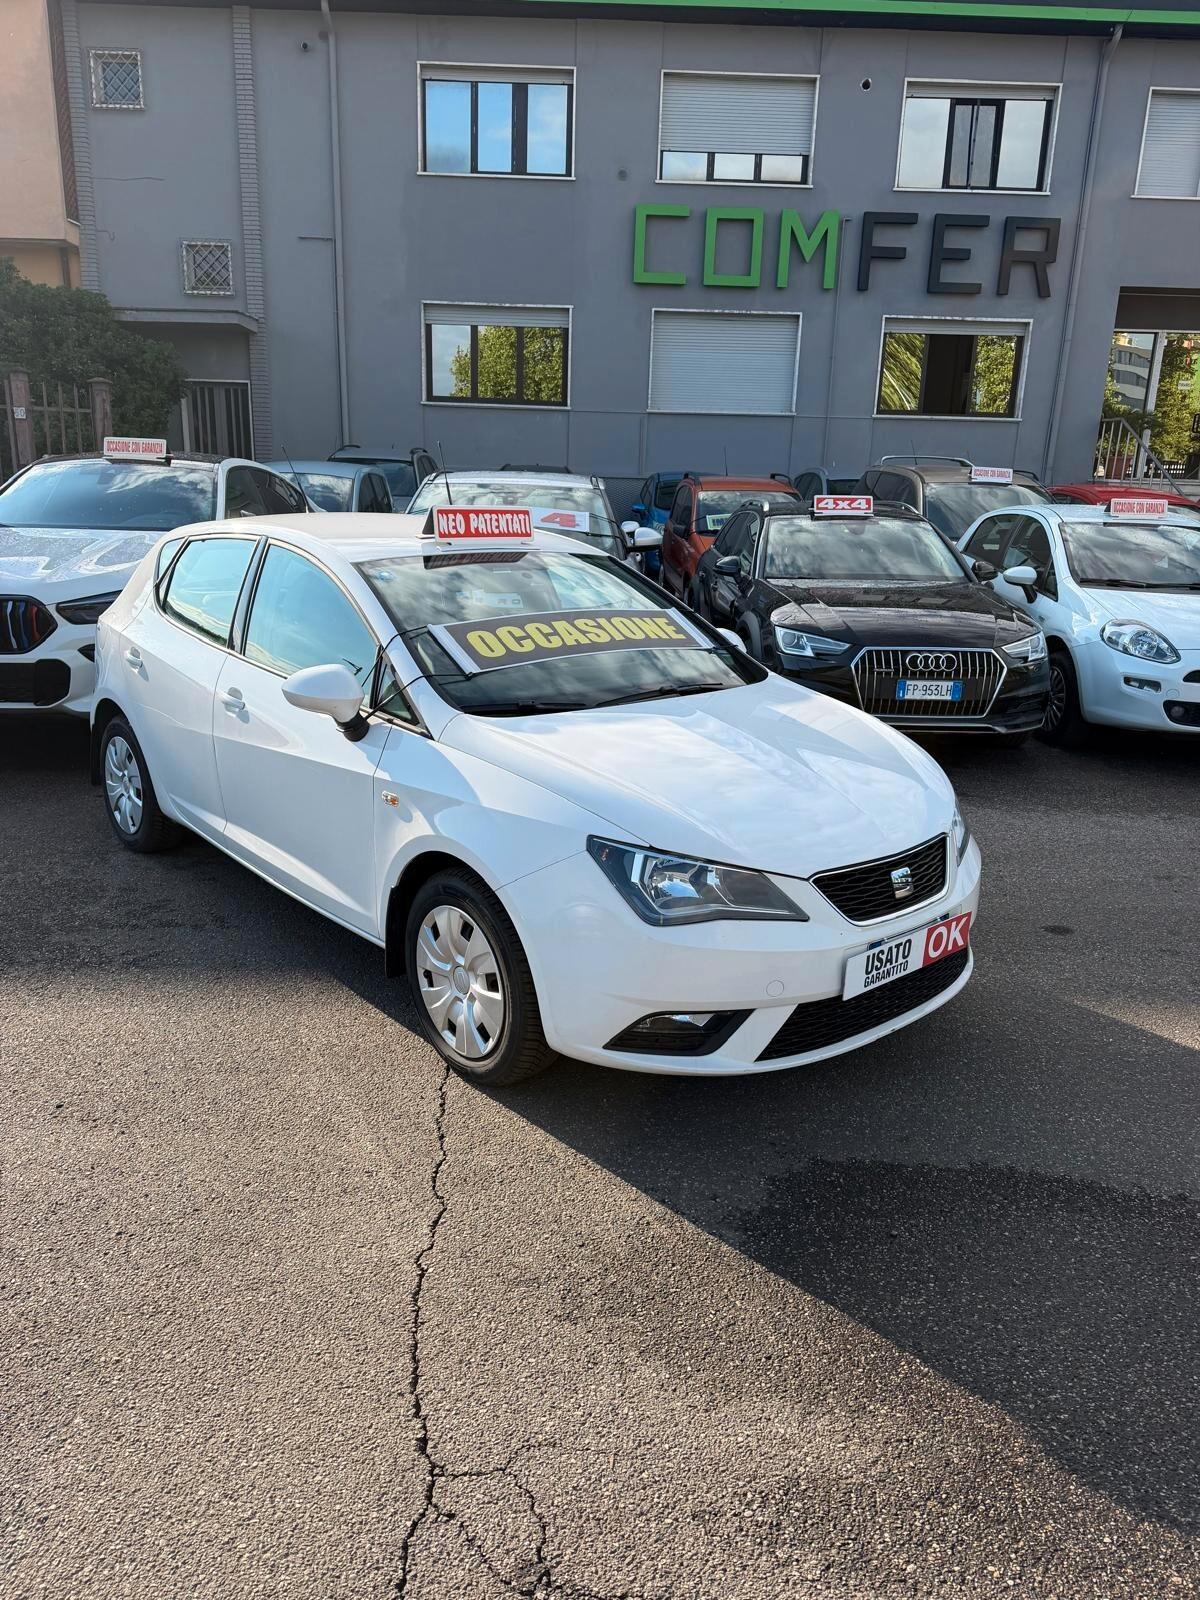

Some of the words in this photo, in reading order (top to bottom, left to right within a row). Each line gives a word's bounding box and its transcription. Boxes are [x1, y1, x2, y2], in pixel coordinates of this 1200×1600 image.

[633, 204, 1061, 298] COMFER
[107, 440, 130, 452] OCCASIONE
[142, 441, 163, 454] GARANZIA
[438, 512, 466, 535] NEO
[470, 512, 531, 535] PATENTATI
[1113, 501, 1136, 513] OCCASIONE
[1146, 502, 1165, 514] GARANZIA
[466, 616, 687, 659] OCCASIONE
[928, 916, 968, 958] OK
[865, 938, 912, 975] USATO
[864, 960, 908, 988] GARANTITO
